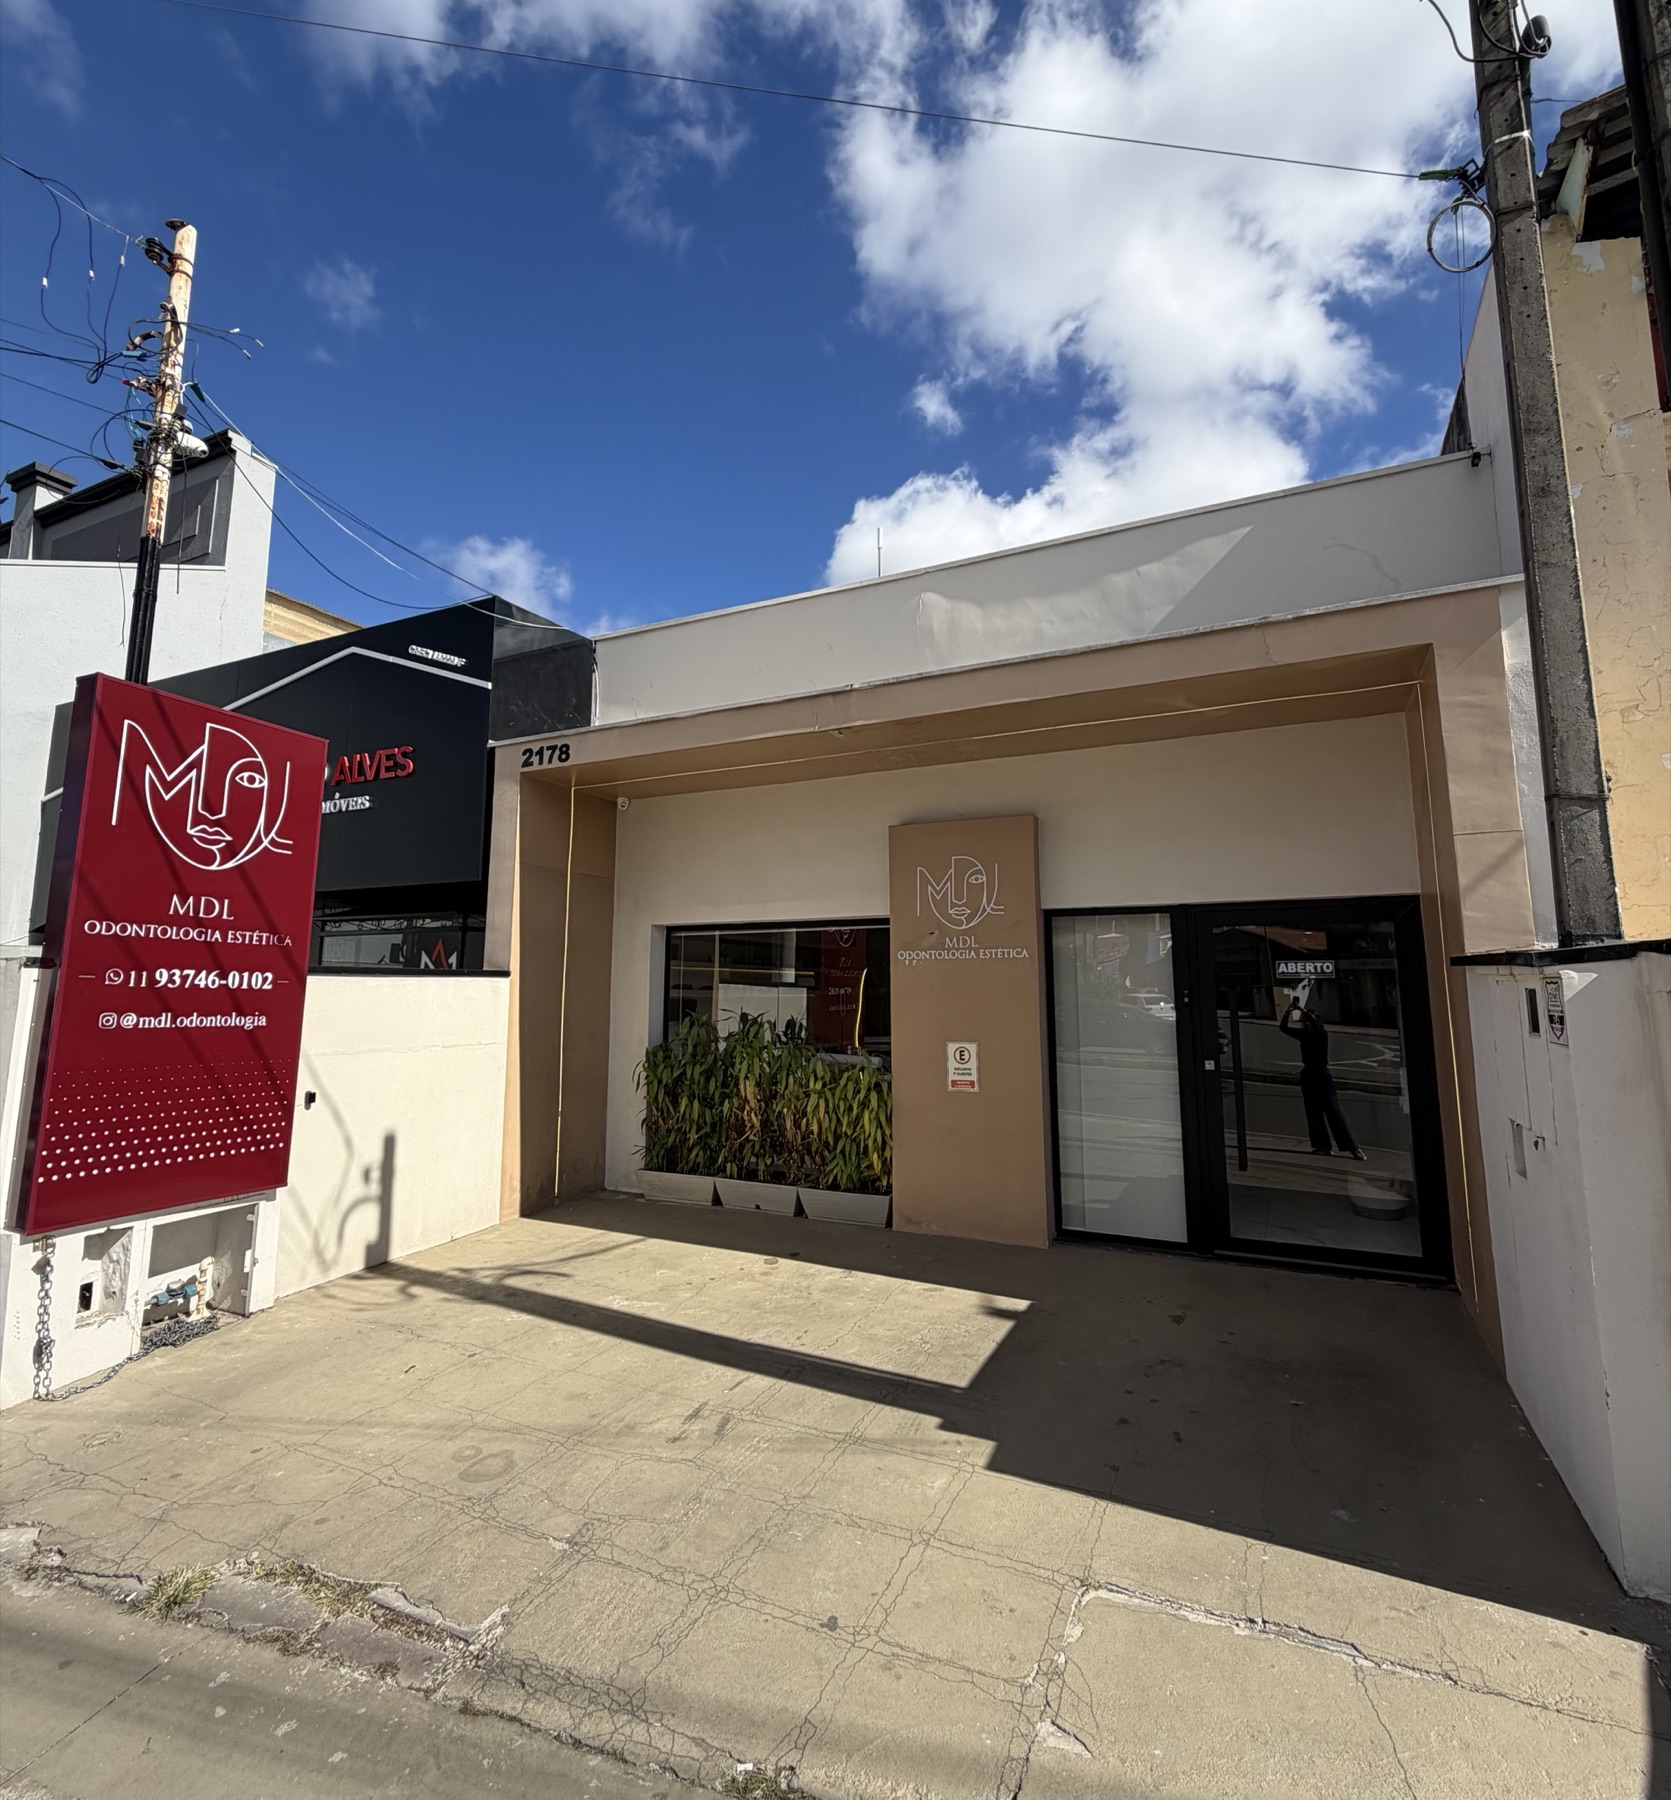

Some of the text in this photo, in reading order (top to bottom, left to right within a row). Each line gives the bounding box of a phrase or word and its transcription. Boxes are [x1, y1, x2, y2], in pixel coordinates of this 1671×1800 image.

[330, 746, 414, 786] ALVES
[521, 743, 571, 768] 2178
[321, 792, 370, 814] MÓVEIS
[168, 893, 234, 920] MDL
[84, 919, 293, 947] ODONTOLOGIA ESTÉTICA
[945, 936, 978, 948] MDL
[897, 947, 1029, 960] ODONTOLOGIA ESTÉTICA
[1278, 962, 1333, 973] ABERTO
[128, 968, 273, 990] 11 93746-0102
[120, 1011, 267, 1030] @mdl.odontologia
